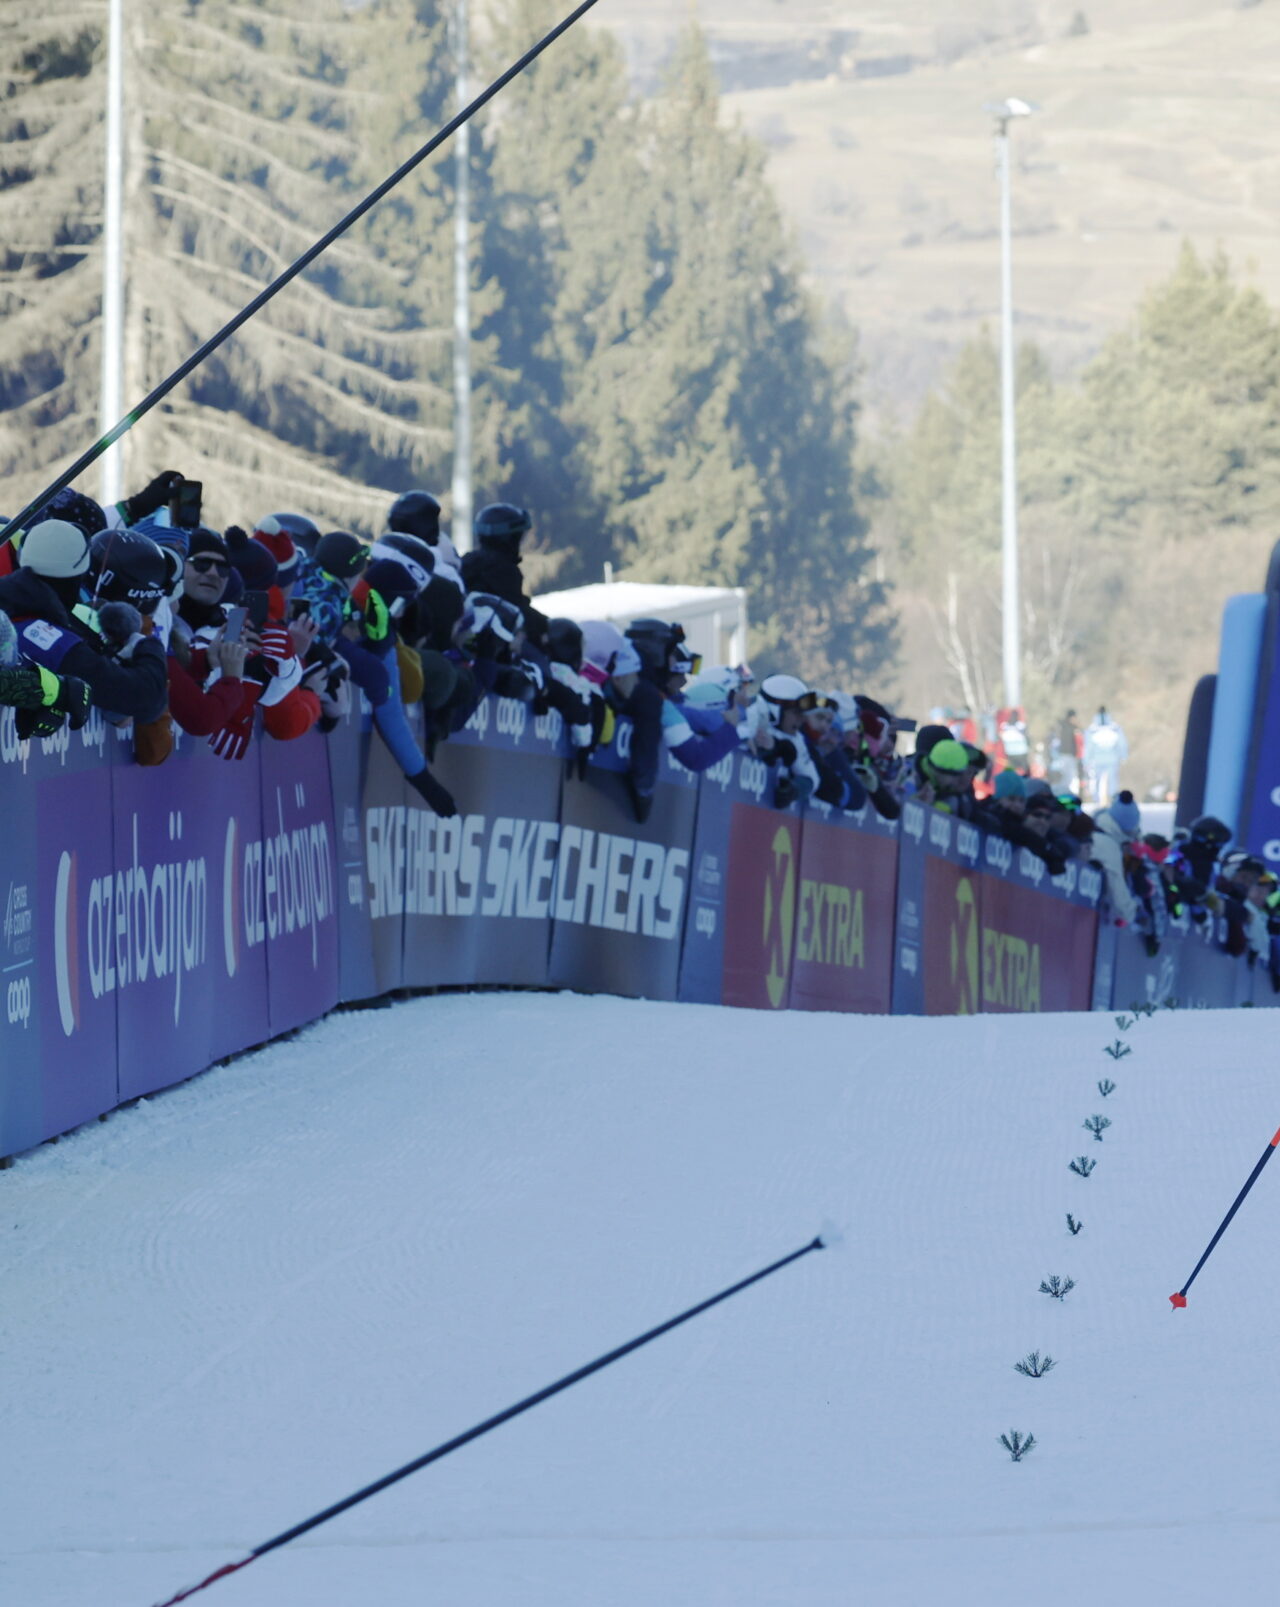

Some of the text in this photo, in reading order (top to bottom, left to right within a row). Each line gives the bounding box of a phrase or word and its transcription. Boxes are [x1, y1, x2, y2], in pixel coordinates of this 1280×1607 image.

[127, 588, 166, 599] uvex
[739, 756, 767, 802] coop
[243, 782, 334, 972] azerbaijan
[365, 805, 486, 920] SKECHERS
[481, 816, 690, 941] SKECHERS
[87, 810, 207, 1028] azerbaijan
[797, 879, 865, 969] EXTRA
[8, 976, 31, 1029] coop
[982, 926, 1041, 1013] EXTRA
